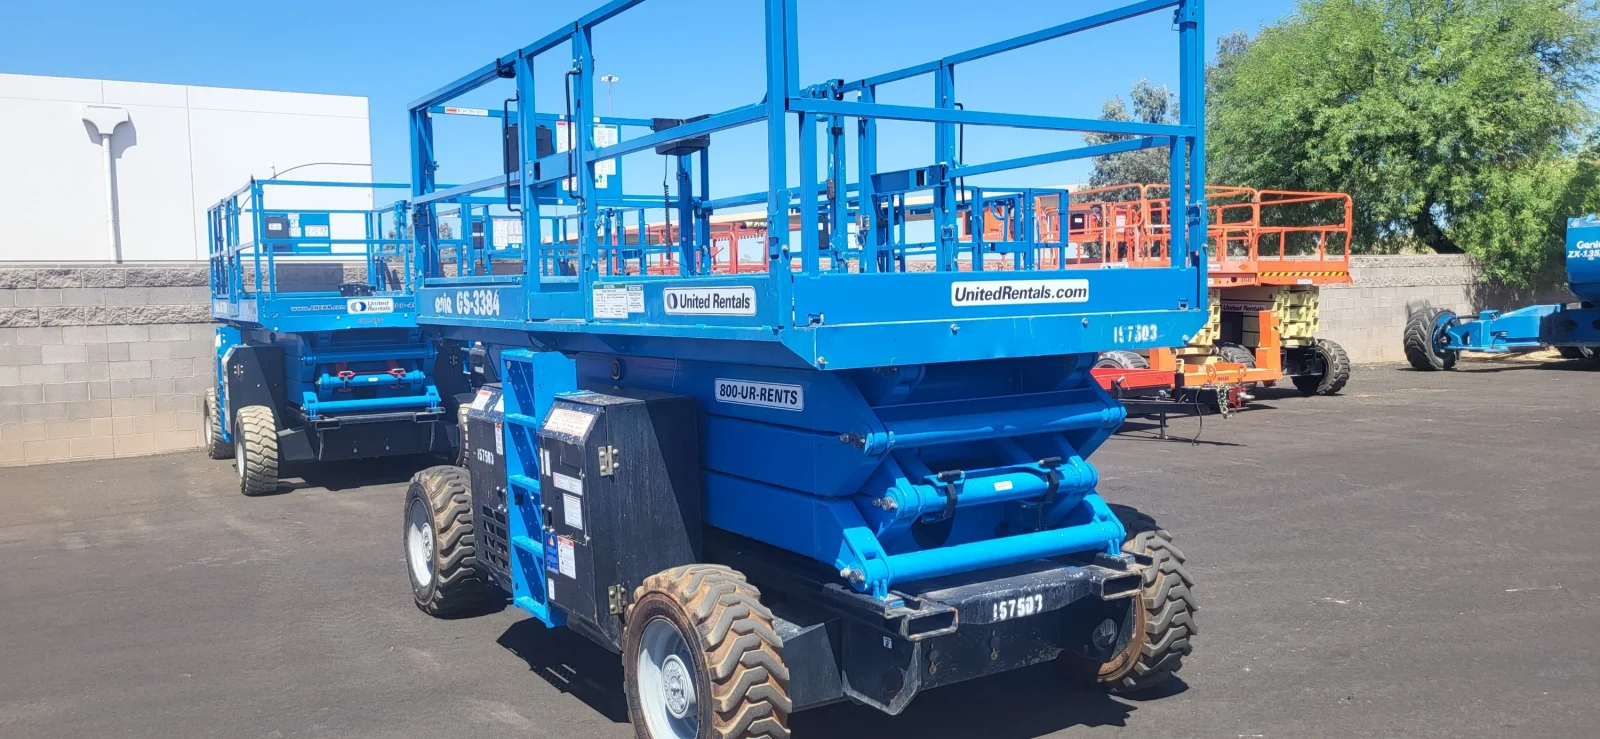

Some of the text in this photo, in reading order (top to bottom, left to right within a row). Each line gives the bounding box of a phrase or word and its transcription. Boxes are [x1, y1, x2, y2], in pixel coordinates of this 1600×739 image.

[1567, 250, 1600, 258] ZX-135
[1576, 240, 1600, 249] Geni
[456, 289, 500, 316] GS-3384
[679, 292, 750, 309] United Rentals
[954, 284, 1087, 302] UnitedRentals.com
[1113, 324, 1158, 344] 157503
[719, 383, 798, 405] 800-UR-RENTS
[993, 594, 1043, 621] 157503
